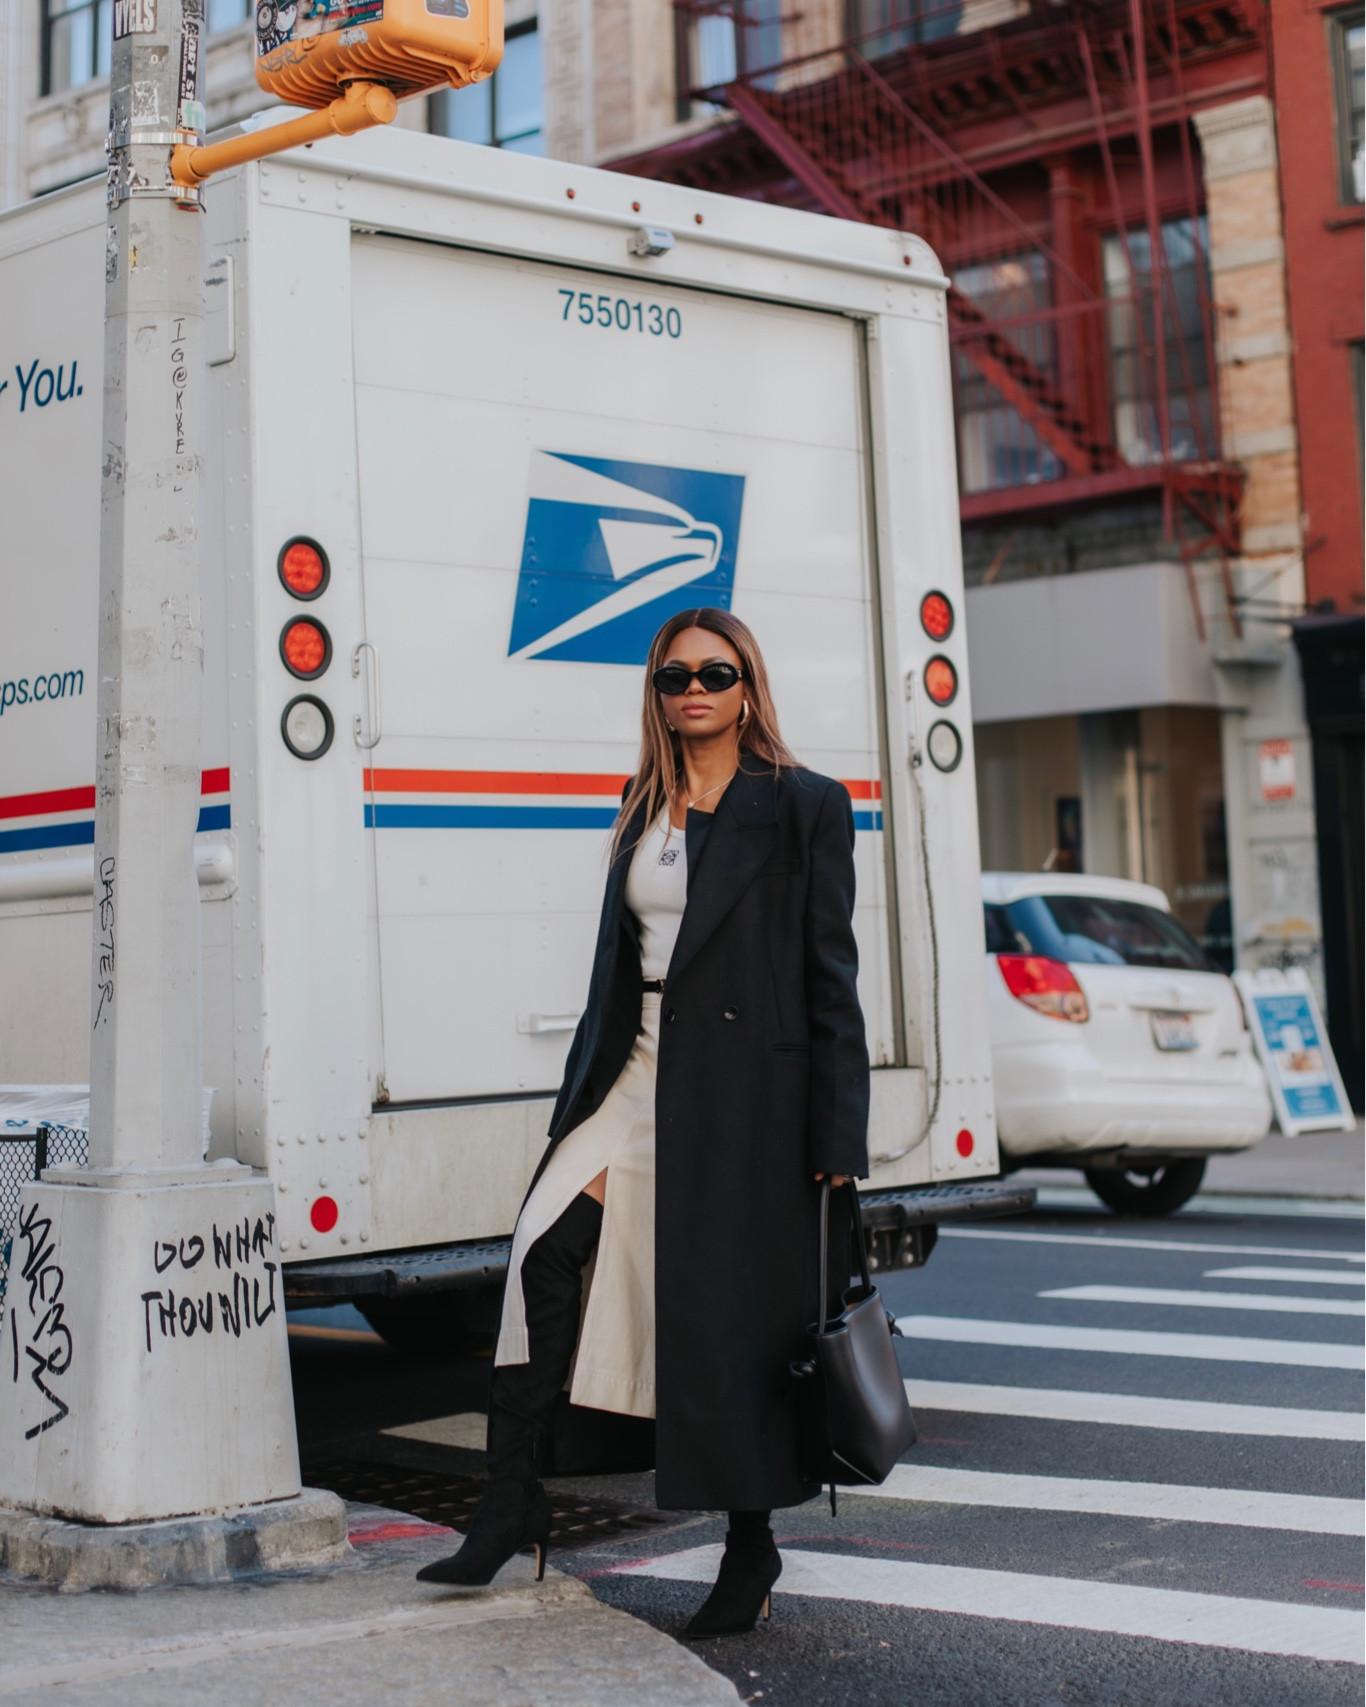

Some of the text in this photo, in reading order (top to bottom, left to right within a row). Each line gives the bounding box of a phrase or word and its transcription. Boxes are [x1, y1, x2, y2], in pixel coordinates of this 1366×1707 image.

[558, 288, 682, 339] 7550130
[15, 358, 83, 412] You.
[0, 668, 84, 716] ps.com
[212, 1211, 275, 1269] WHAT
[140, 1288, 213, 1353] THOU
